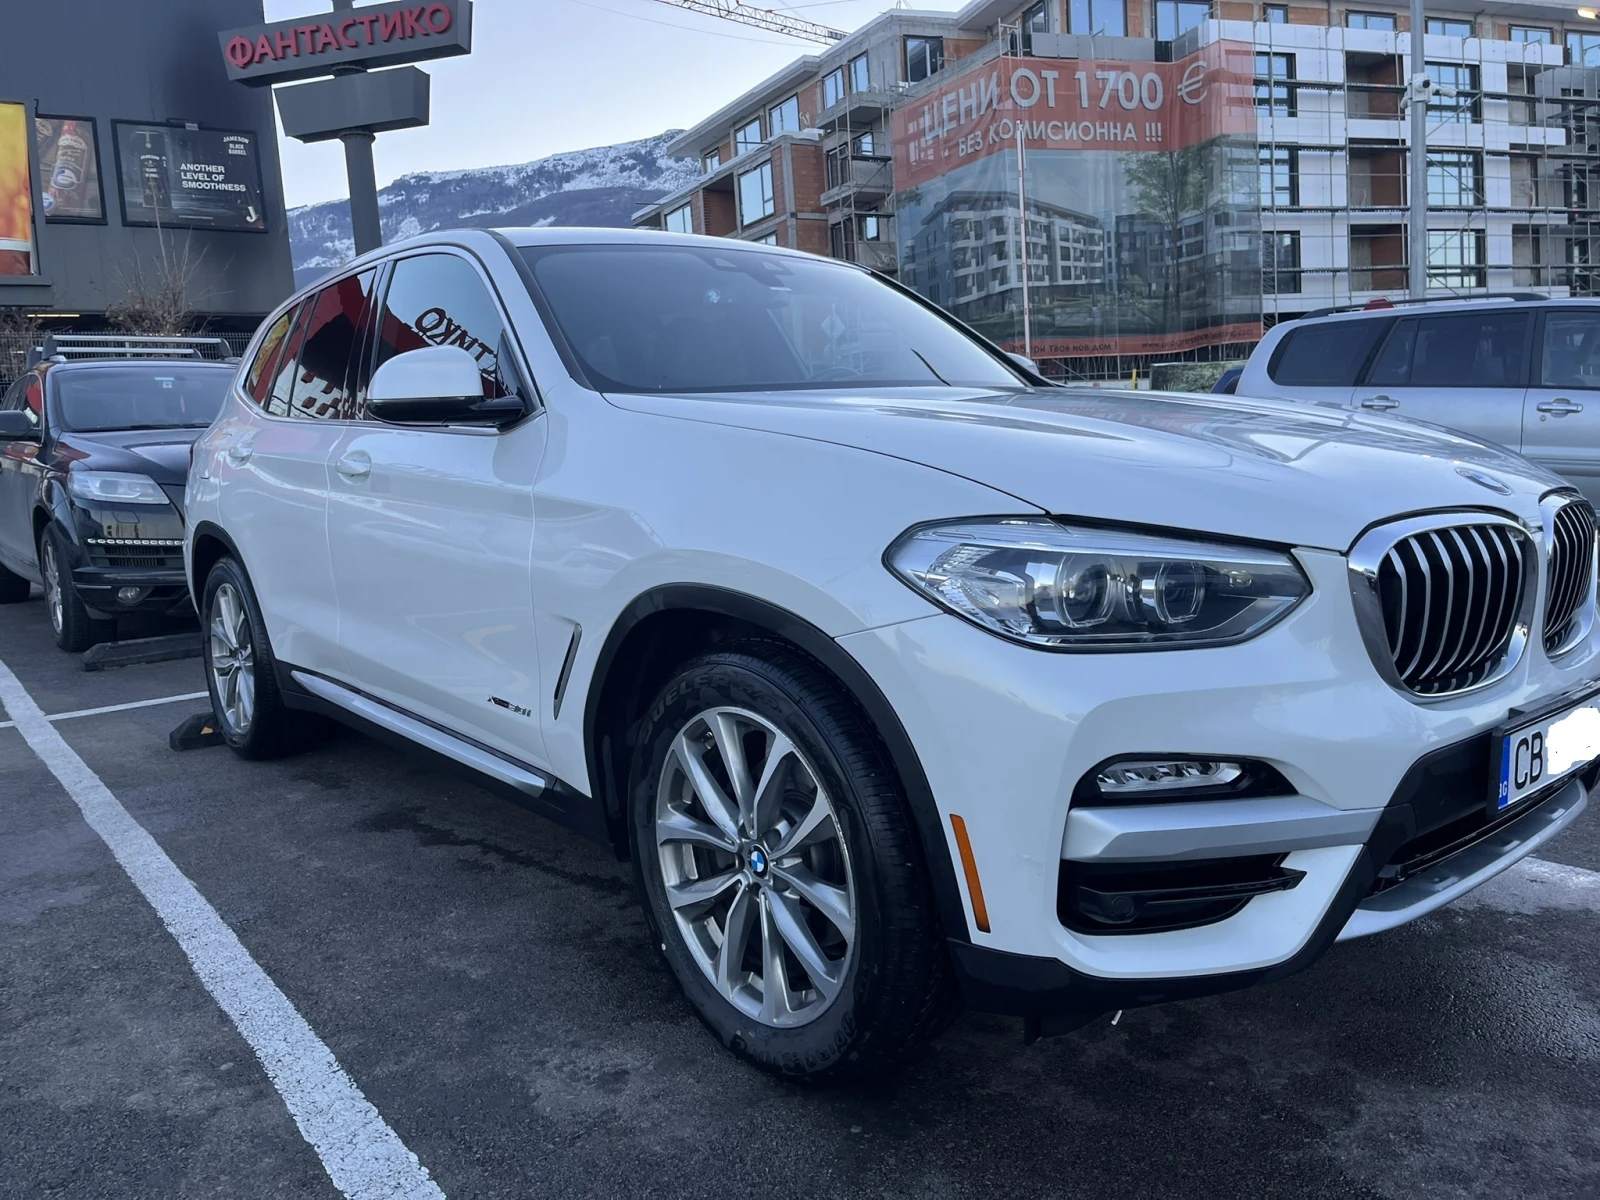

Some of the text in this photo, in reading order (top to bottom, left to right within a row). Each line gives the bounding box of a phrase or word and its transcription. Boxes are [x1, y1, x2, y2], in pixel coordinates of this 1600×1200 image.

[226, 3, 452, 69] ФАНТАСТИКО
[923, 60, 1208, 142] ЦЕНИ ОТ 1700 €
[223, 135, 250, 144] JAMESON
[958, 130, 984, 158] БЕЗ
[1145, 122, 1163, 142] !!!
[180, 163, 226, 173] ANOTHER
[180, 172, 225, 181] LEVEL OF
[182, 181, 247, 192] SMOOTHNESS
